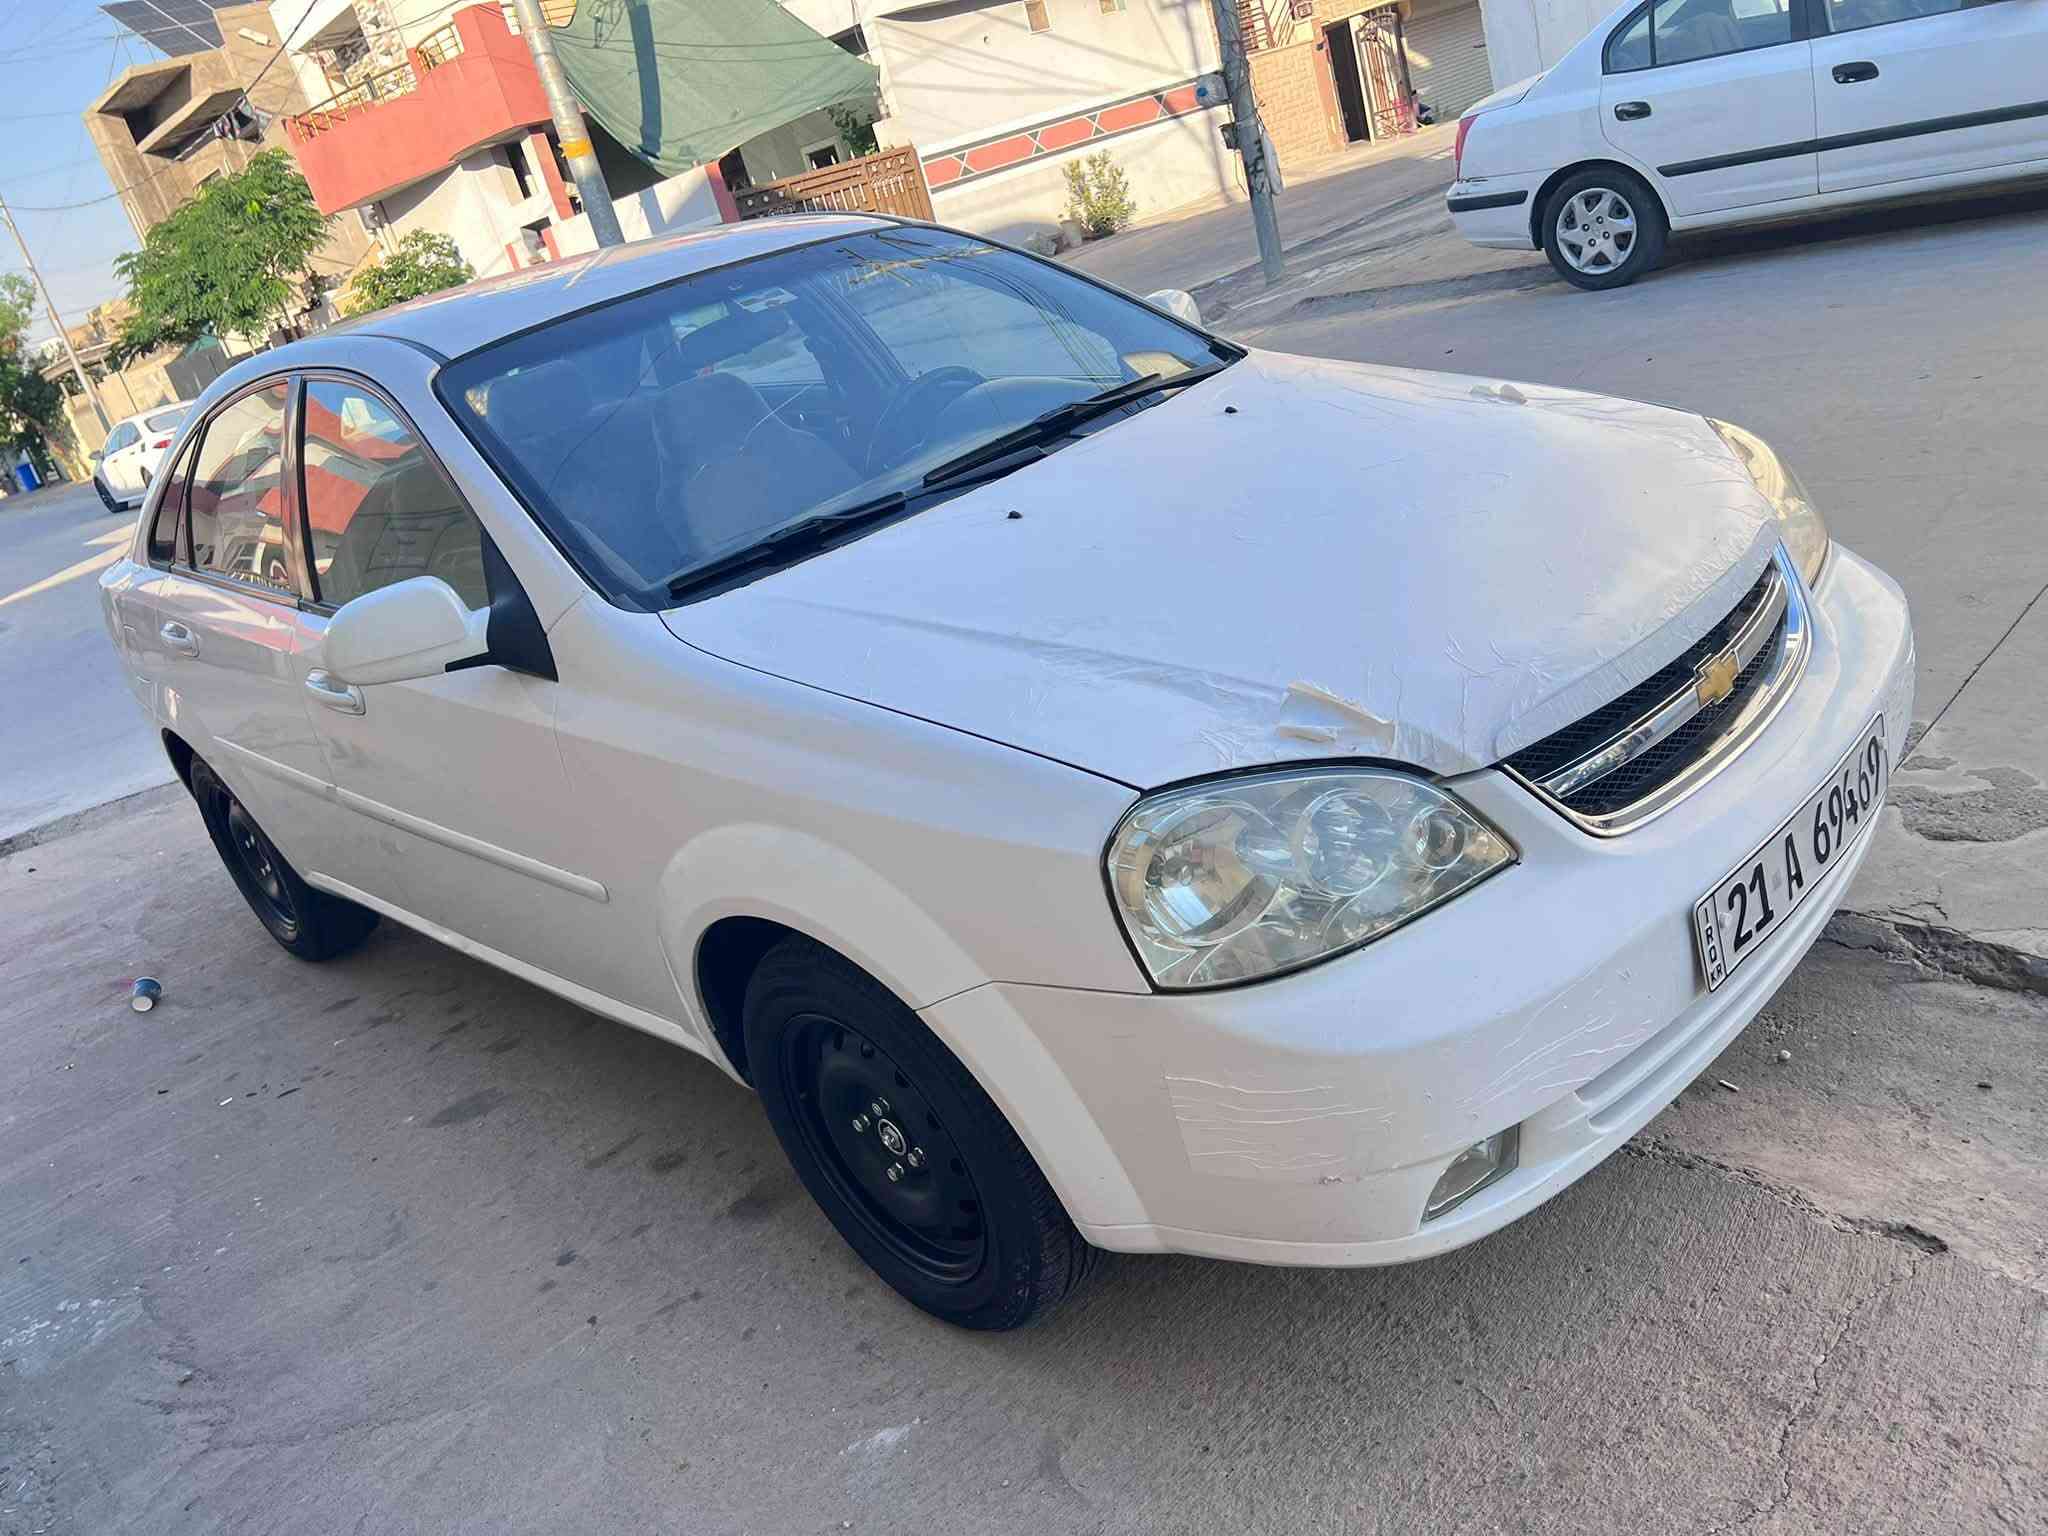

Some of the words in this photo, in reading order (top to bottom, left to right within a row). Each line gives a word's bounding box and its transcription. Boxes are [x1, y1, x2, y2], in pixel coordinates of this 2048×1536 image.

[1728, 862, 1774, 952] 21
[1784, 832, 1804, 900] A
[1813, 735, 1881, 864] 69469
